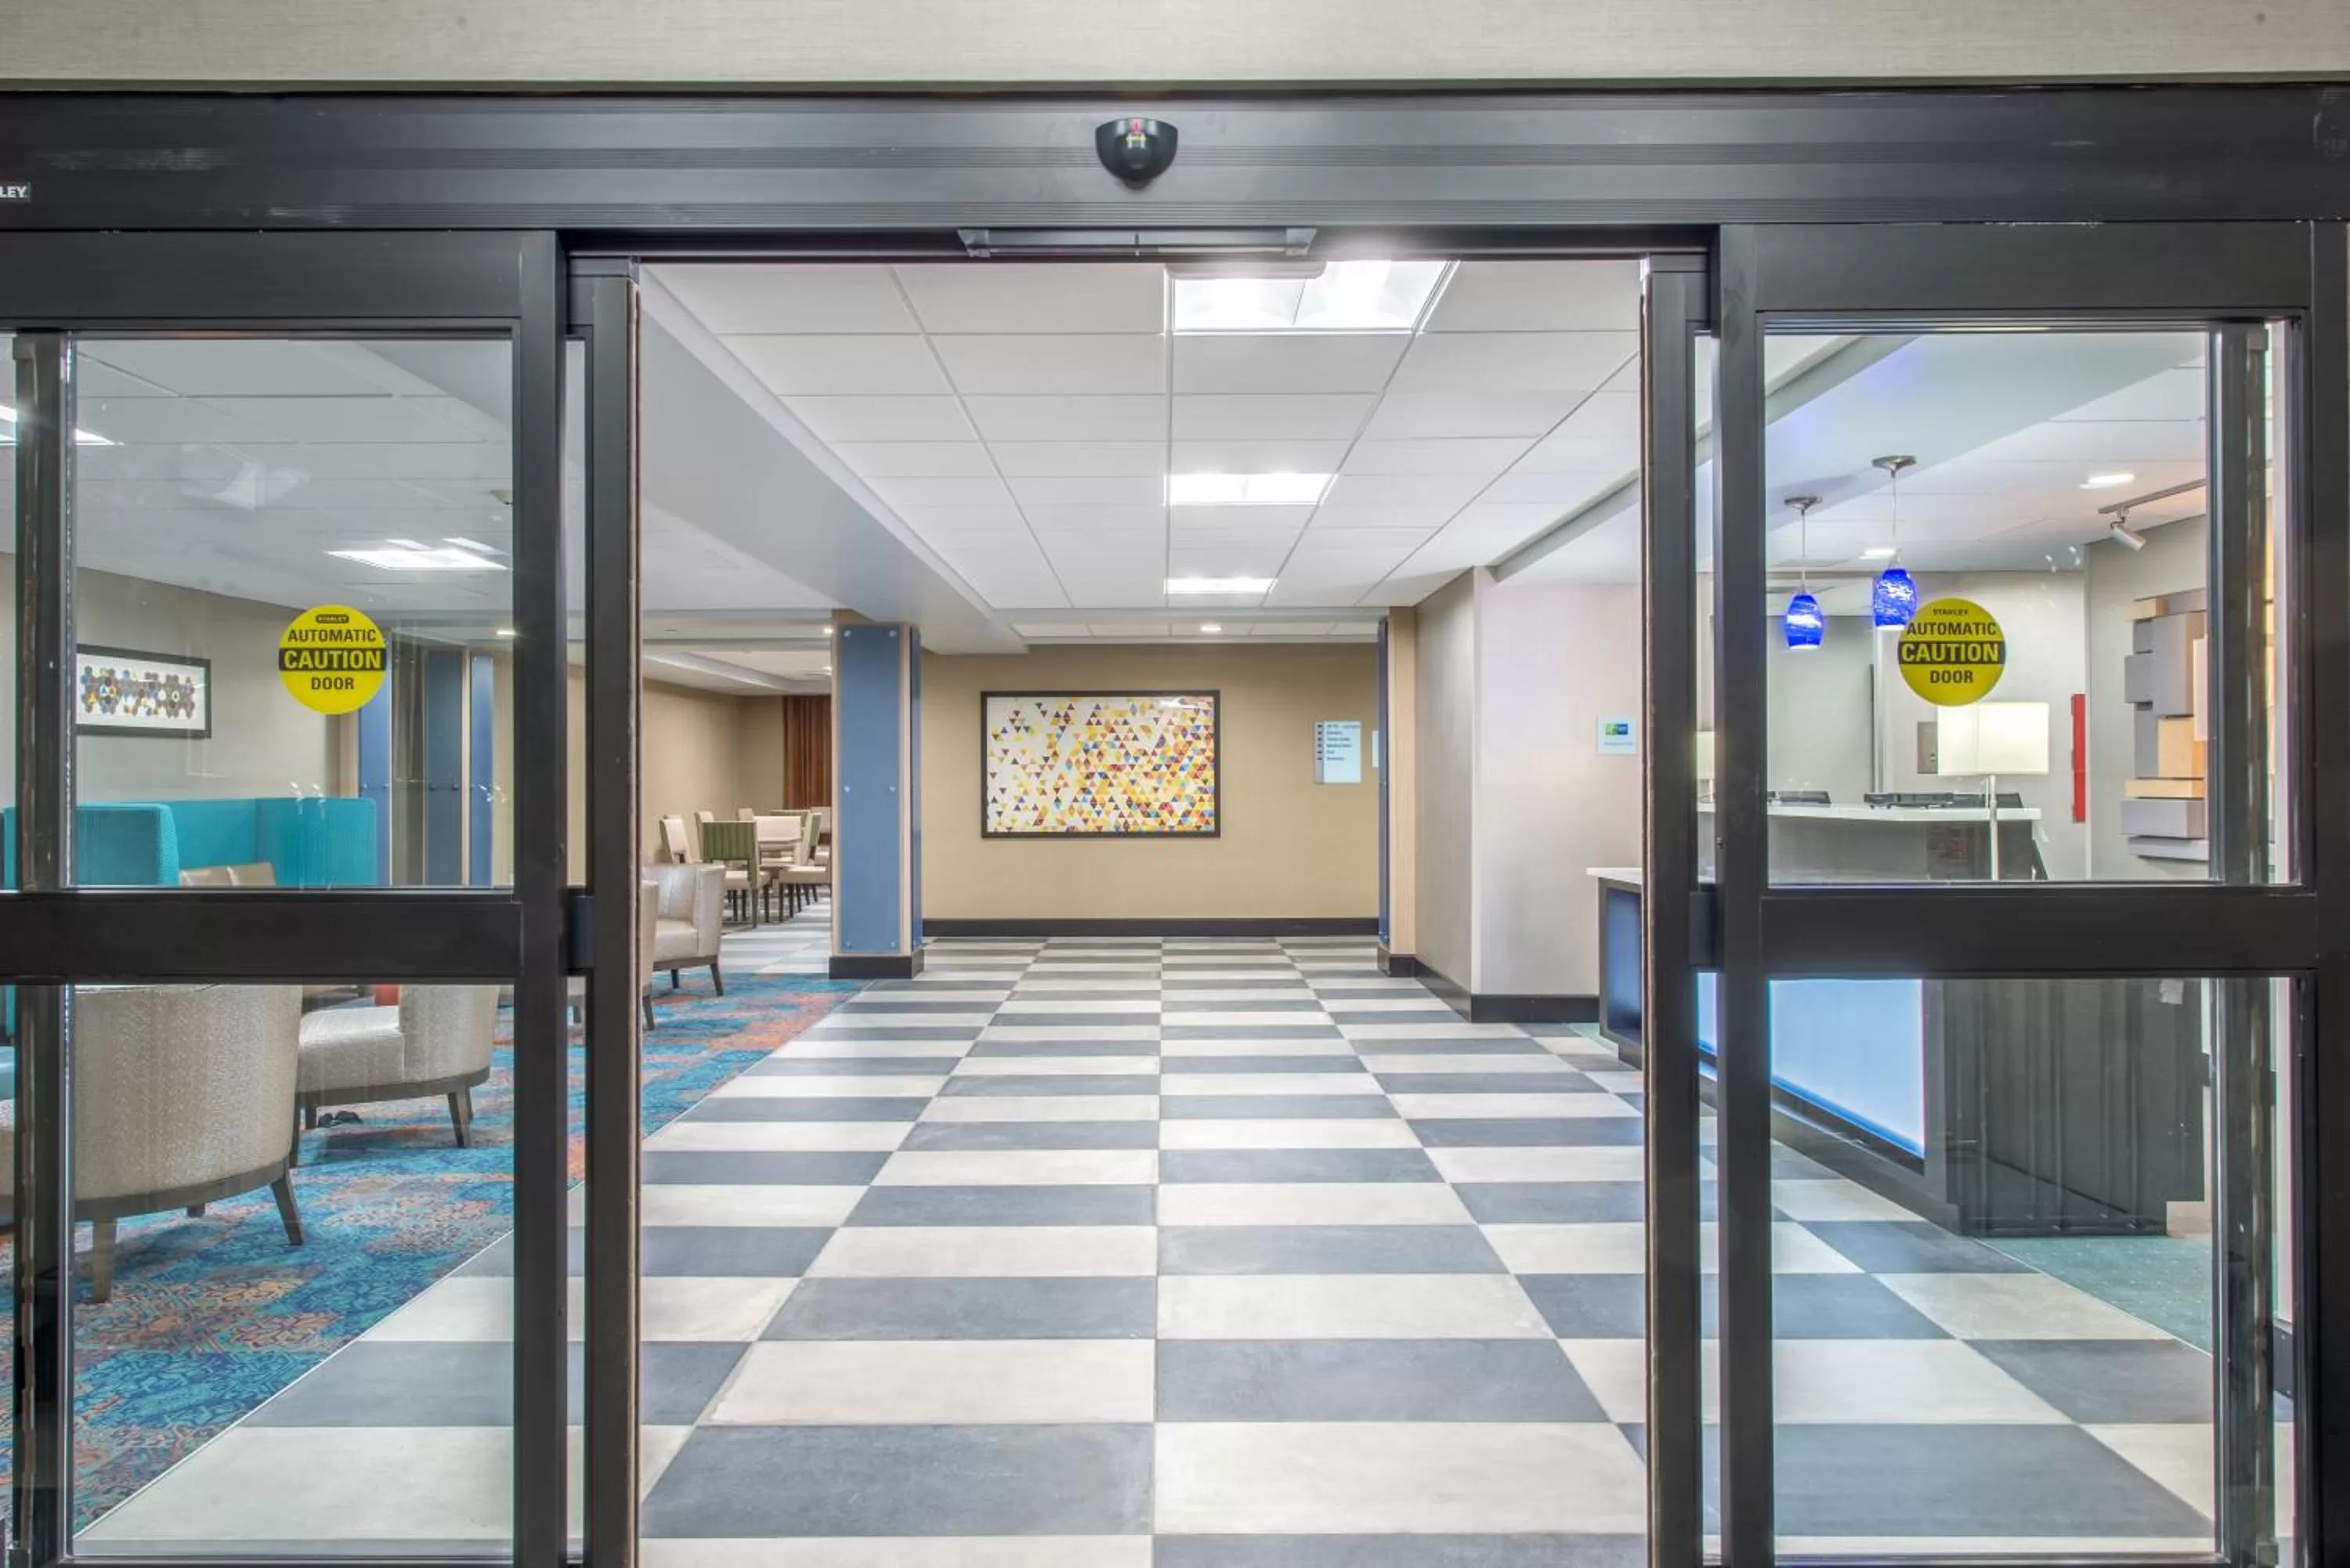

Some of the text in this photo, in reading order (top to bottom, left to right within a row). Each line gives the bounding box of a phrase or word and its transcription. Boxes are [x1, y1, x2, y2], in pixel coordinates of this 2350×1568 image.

[1907, 622, 1997, 635] AUTOMATIC
[287, 629, 377, 642] AUTOMATIC
[1901, 643, 1998, 662] CAUTION
[284, 650, 381, 669] CAUTION
[311, 677, 355, 690] DOOR
[1929, 670, 1974, 684] DOOR
